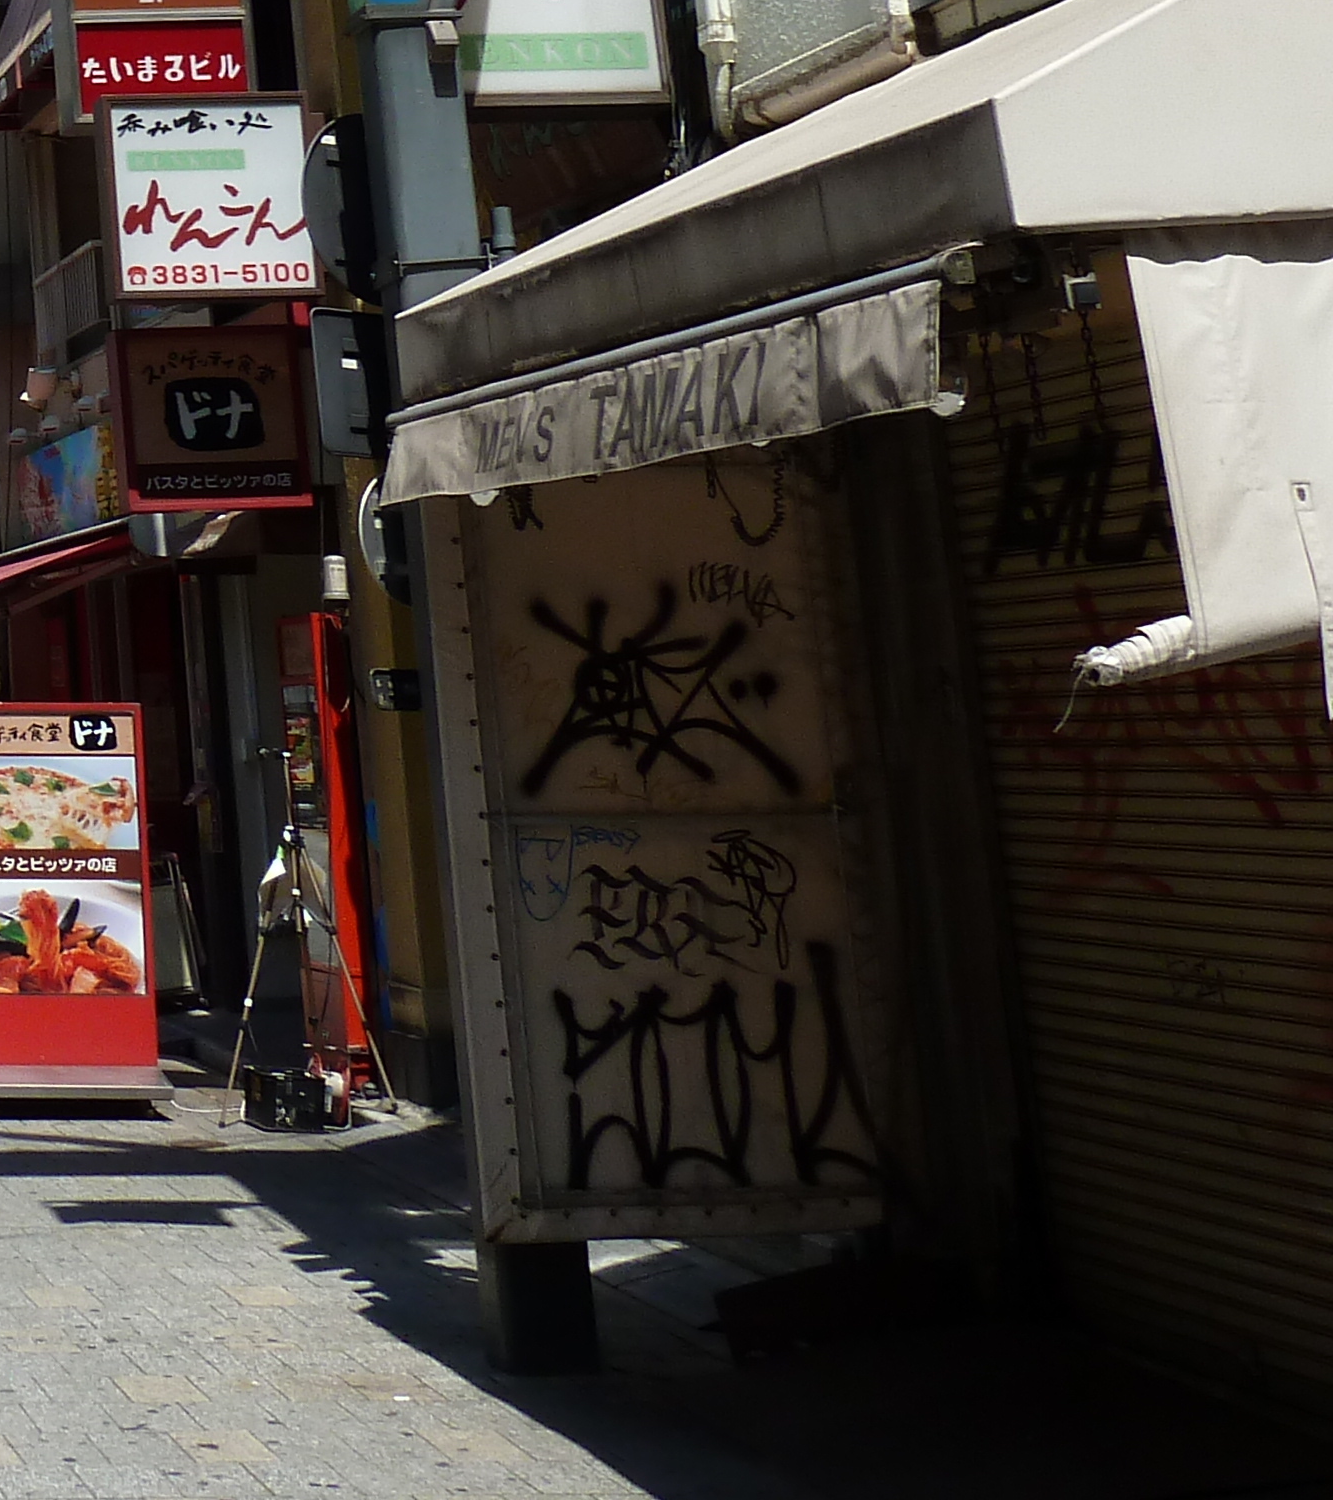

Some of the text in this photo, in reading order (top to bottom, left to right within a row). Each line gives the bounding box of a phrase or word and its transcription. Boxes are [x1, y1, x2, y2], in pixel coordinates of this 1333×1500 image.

[82, 52, 242, 83] たいまるビル
[118, 111, 273, 137] 呑み喰い処
[124, 179, 307, 251] れんこん
[153, 262, 308, 283] 3831-5100
[178, 391, 254, 439] ドナ
[588, 343, 767, 462] TAMAKI
[146, 473, 292, 491] パスタとピッツァの店
[72, 718, 115, 748] ドナ
